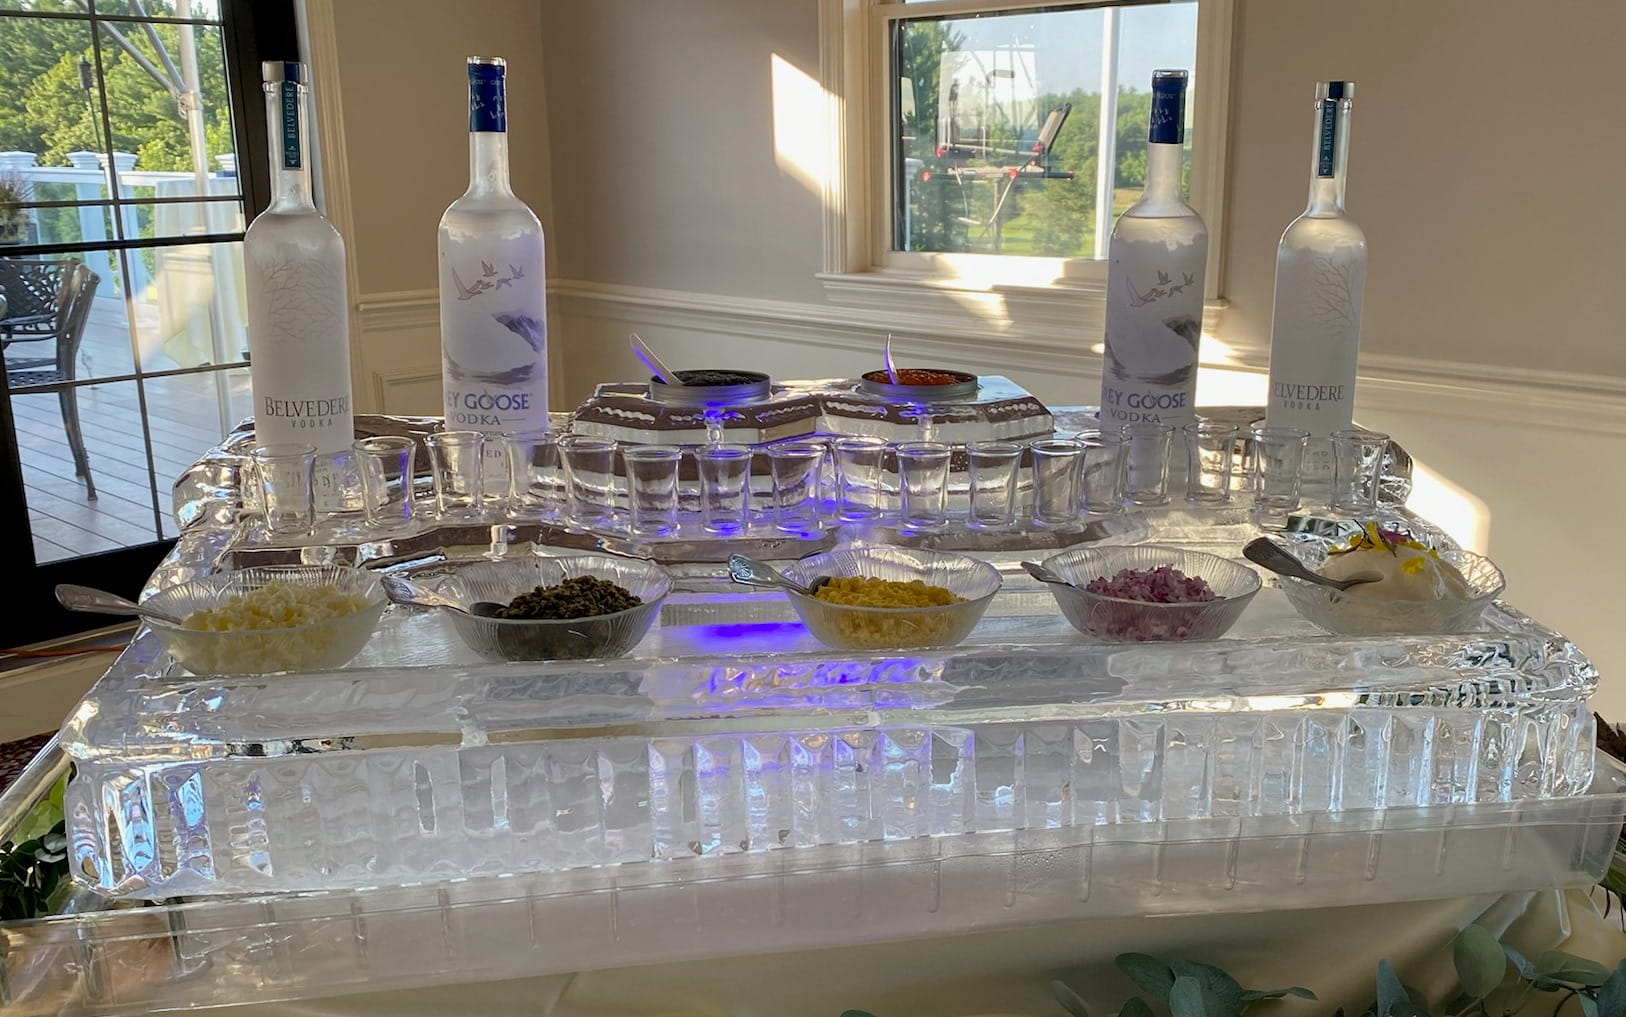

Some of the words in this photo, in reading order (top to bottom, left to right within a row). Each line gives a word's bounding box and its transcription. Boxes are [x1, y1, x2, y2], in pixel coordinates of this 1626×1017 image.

[285, 85, 297, 139] BELVEDERE
[464, 389, 530, 411] GOOSE
[1127, 390, 1187, 410] GOOSE
[1275, 383, 1345, 402] ELVEDERE
[291, 418, 334, 429] VODKA
[451, 410, 502, 426] VODKA
[1110, 407, 1161, 424] VODKA
